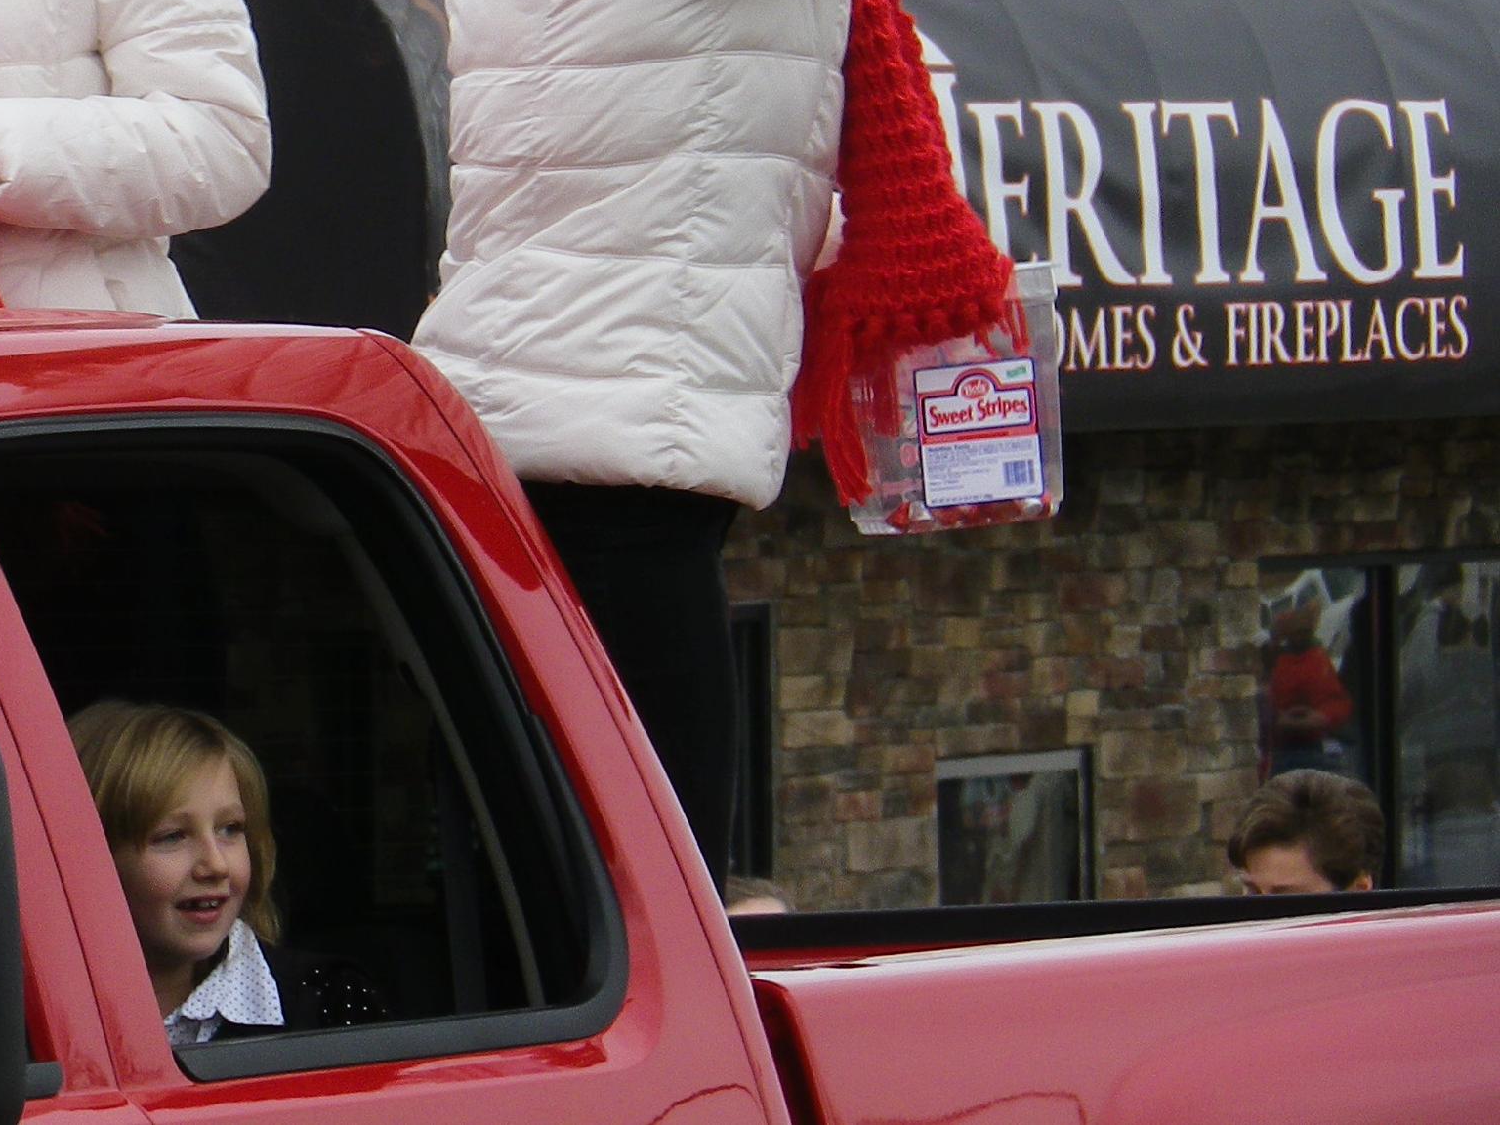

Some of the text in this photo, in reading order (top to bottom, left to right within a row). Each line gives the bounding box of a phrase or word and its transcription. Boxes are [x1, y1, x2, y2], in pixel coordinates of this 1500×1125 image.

[1171, 304, 1208, 368] &
[1224, 294, 1470, 367] FIREPLACES
[929, 395, 1028, 428] Sweet Stripes
